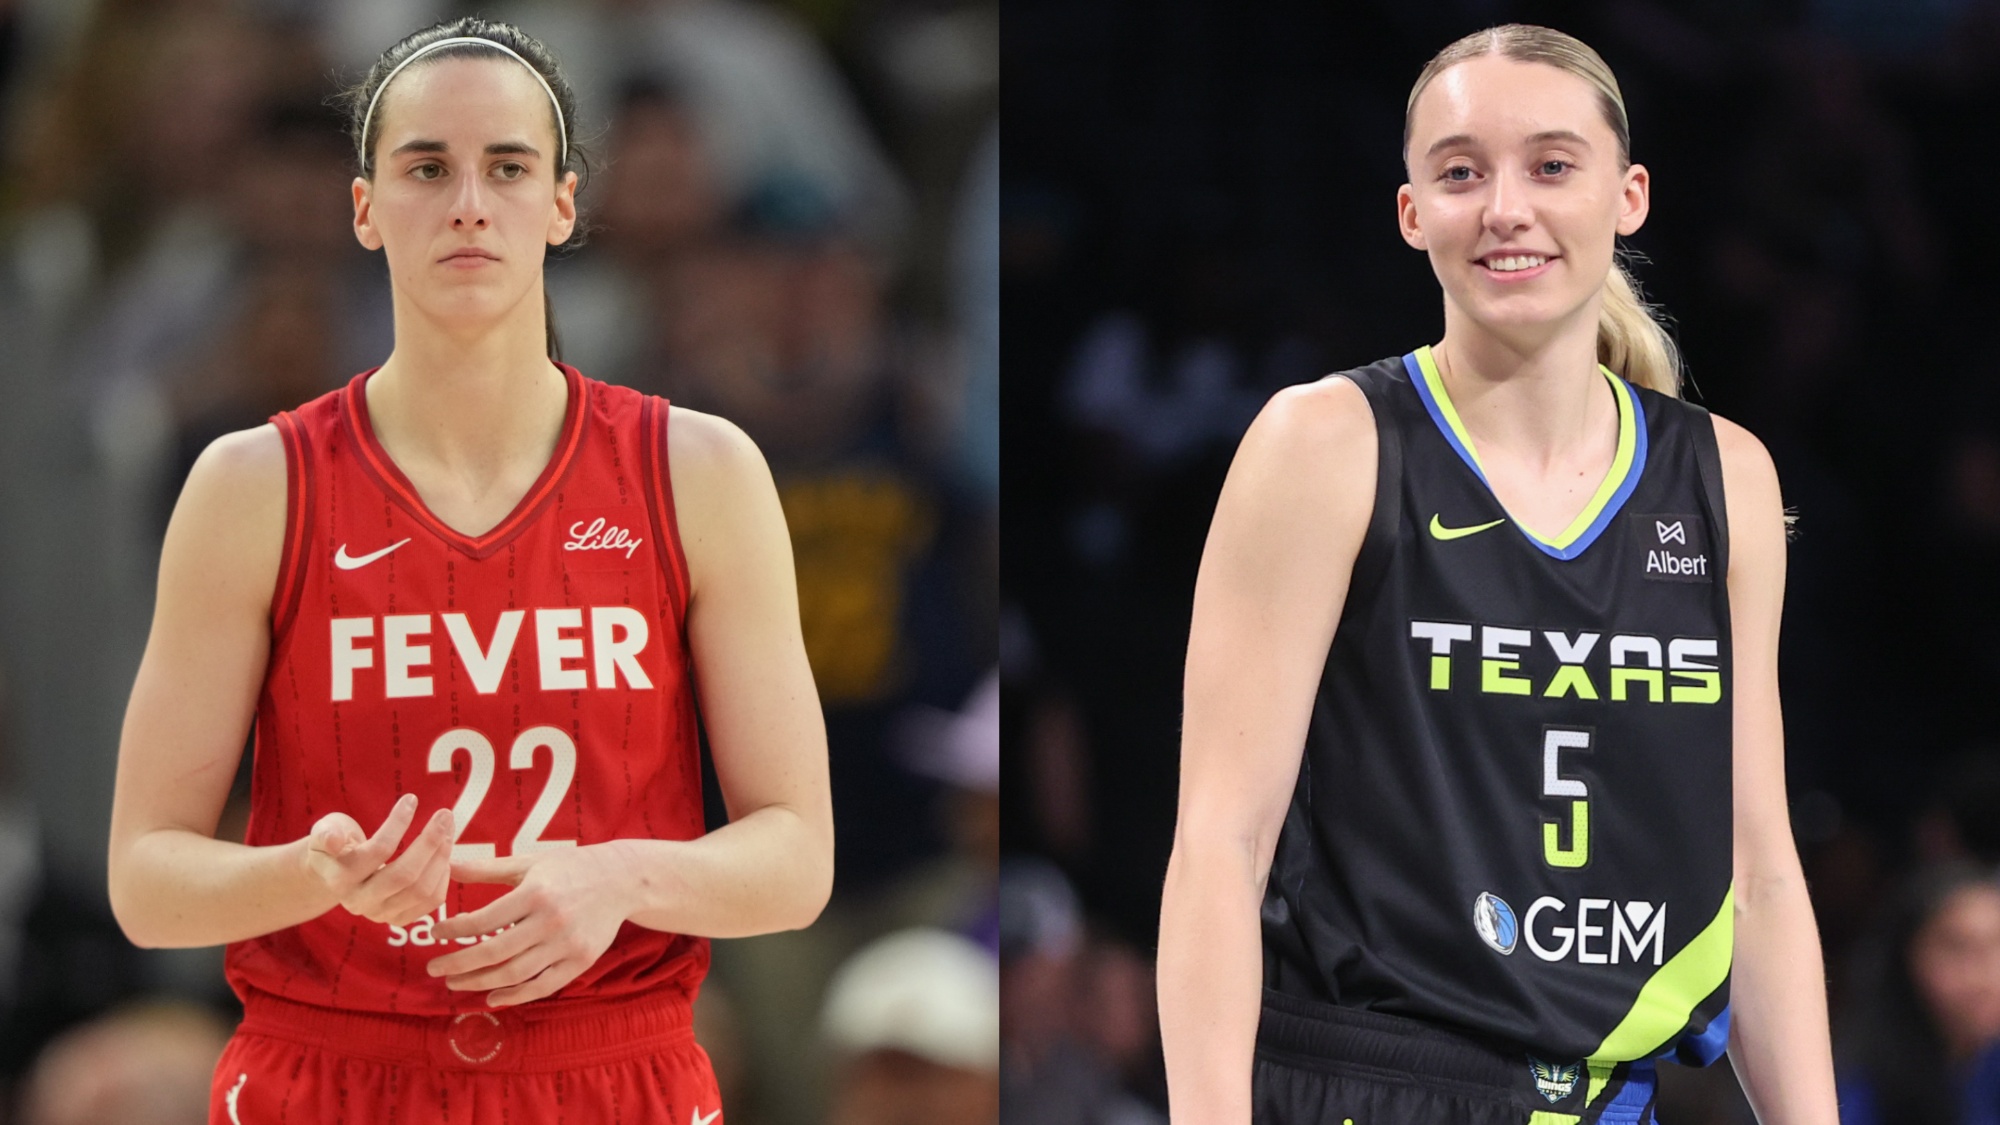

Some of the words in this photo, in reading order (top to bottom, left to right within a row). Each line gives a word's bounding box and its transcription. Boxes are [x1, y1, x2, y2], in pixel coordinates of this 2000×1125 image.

[564, 517, 643, 559] Lilly
[1646, 550, 1708, 576] Albert
[330, 608, 654, 702] FEVER
[1411, 621, 1722, 704] TEXAS
[427, 725, 578, 861] 22
[1543, 730, 1590, 868] 5
[1523, 896, 1667, 966] GEM
[1537, 1078, 1572, 1093] WINGS
